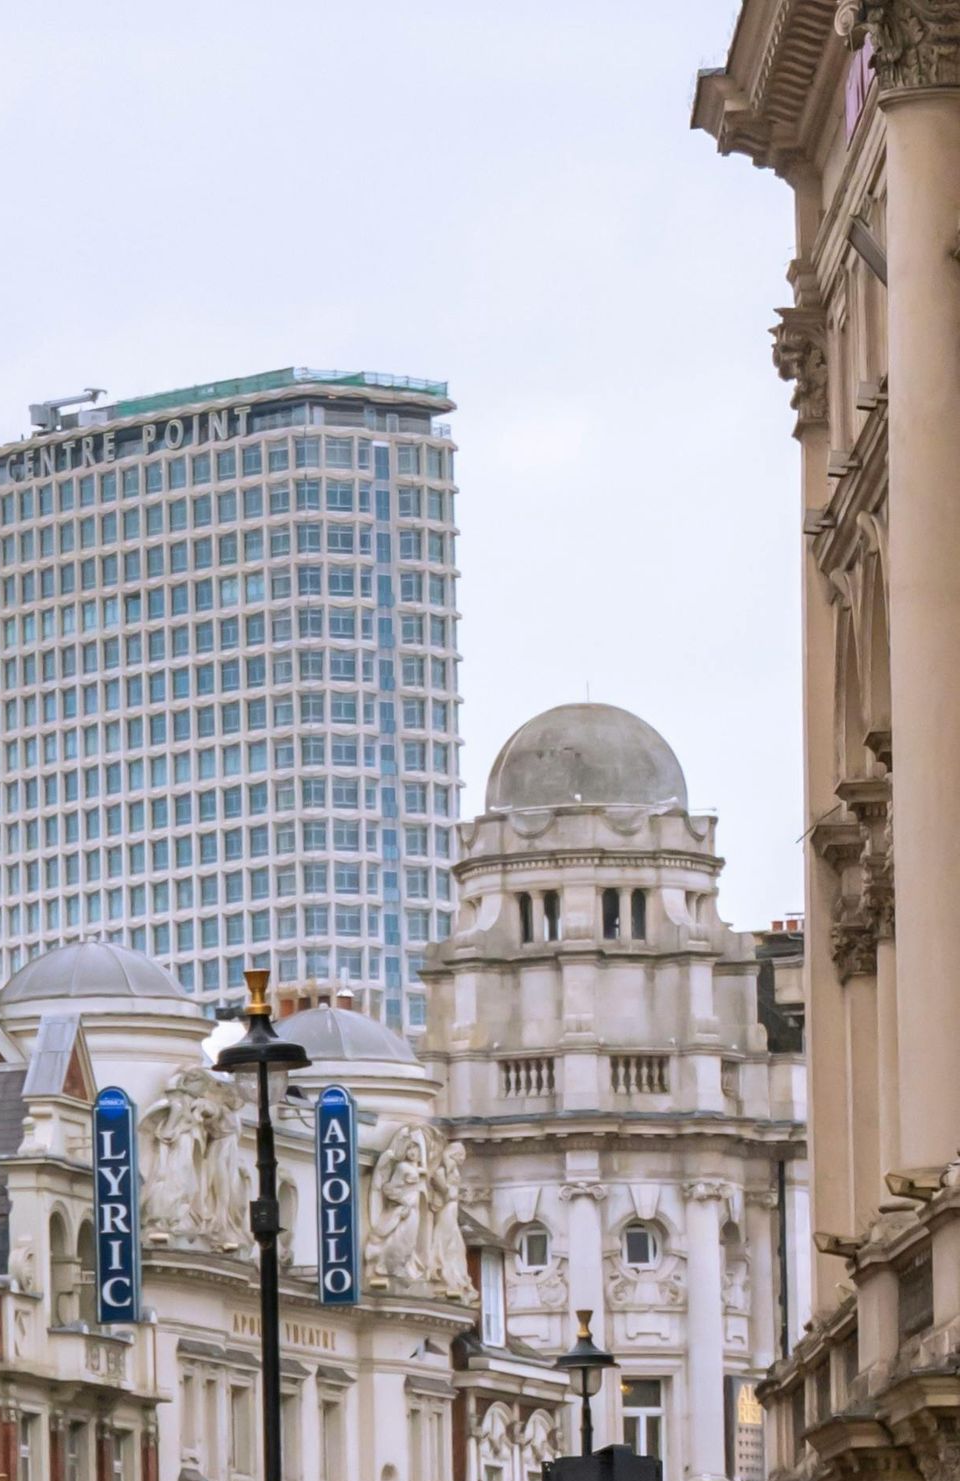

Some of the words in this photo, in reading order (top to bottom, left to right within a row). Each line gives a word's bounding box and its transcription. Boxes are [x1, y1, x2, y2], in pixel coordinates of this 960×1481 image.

[6, 431, 116, 483] CENTRE
[142, 405, 252, 456] POINT
[99, 1130, 132, 1307] LYRIC
[322, 1119, 352, 1294] APOLLO
